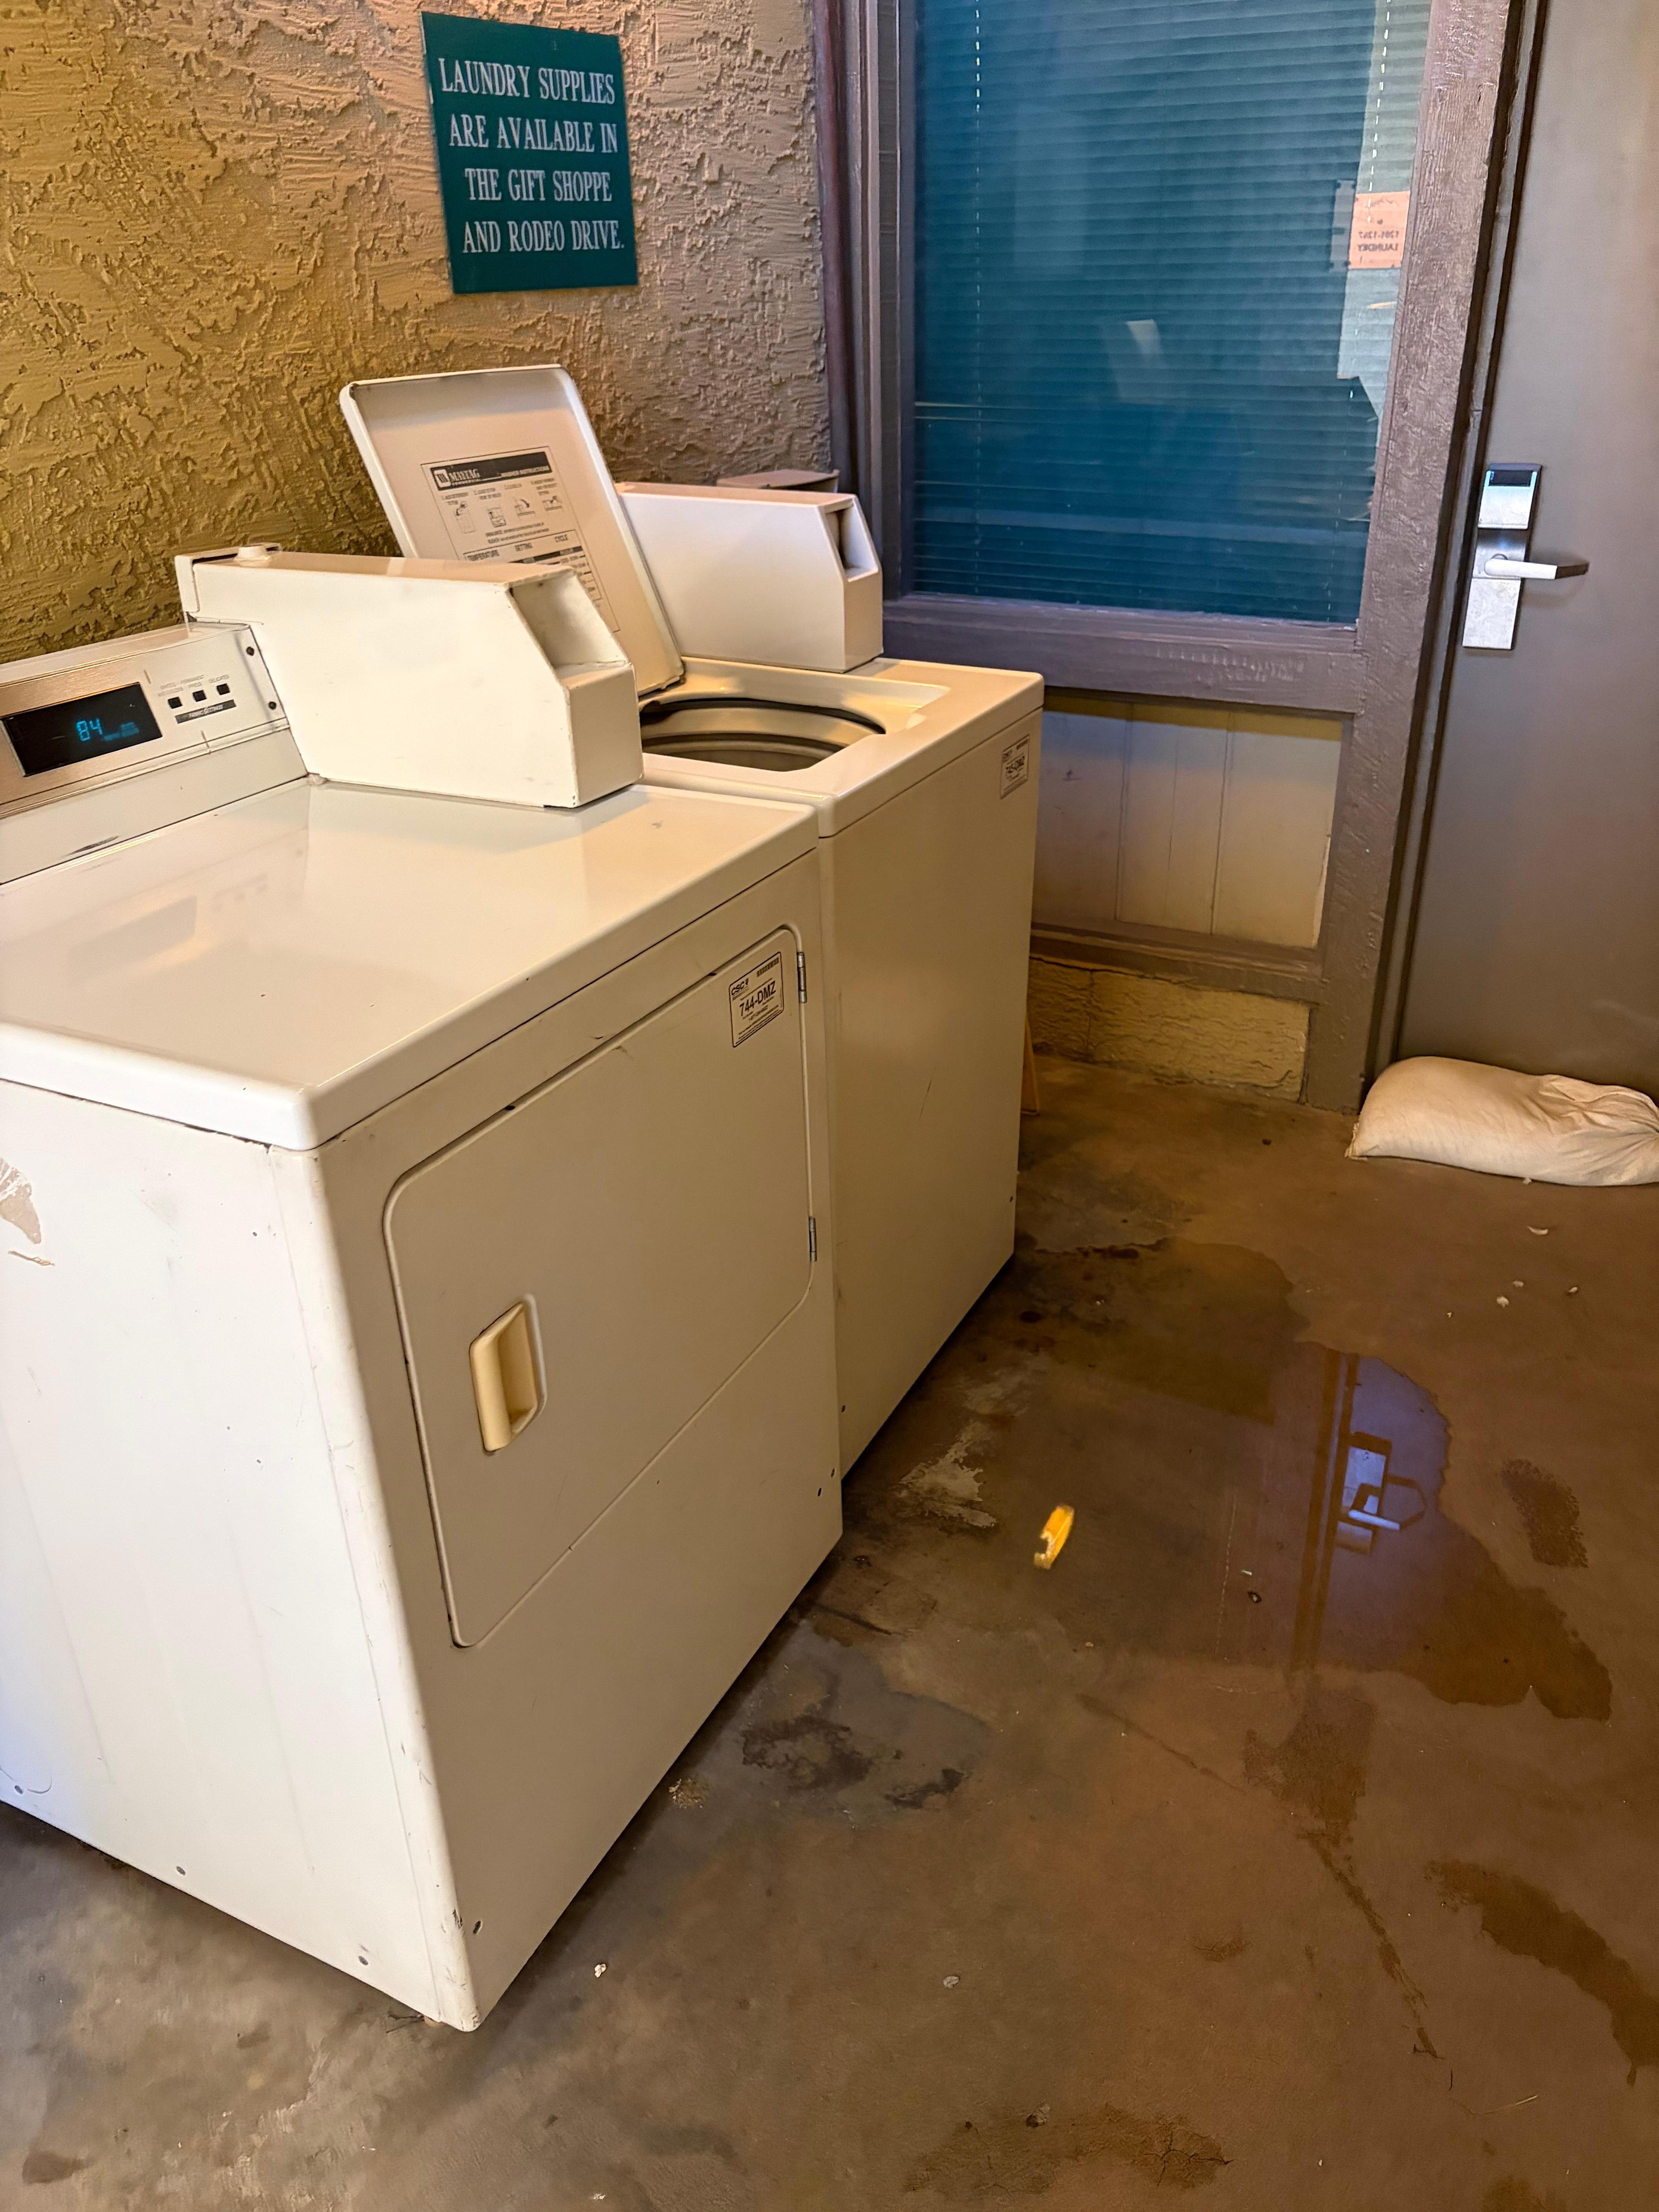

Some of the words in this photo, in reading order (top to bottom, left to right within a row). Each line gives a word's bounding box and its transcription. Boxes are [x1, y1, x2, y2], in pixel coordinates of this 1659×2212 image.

[438, 58, 531, 98] LAUNDRY
[538, 67, 615, 105] SUPPLIES
[449, 114, 489, 148] ARE
[497, 117, 595, 153] AVAILABLE
[600, 123, 618, 153] IN
[465, 168, 501, 201] THE
[508, 169, 546, 201] GIFT
[553, 171, 612, 202] SHOPPE
[462, 221, 501, 254] AND
[507, 221, 565, 251] RODEO
[572, 220, 625, 250] DRIVE.
[448, 469, 481, 481] MAYTAG
[555, 534, 568, 543] CYCLE
[76, 718, 103, 741] 84
[739, 981, 776, 1017] 744-DMZ
